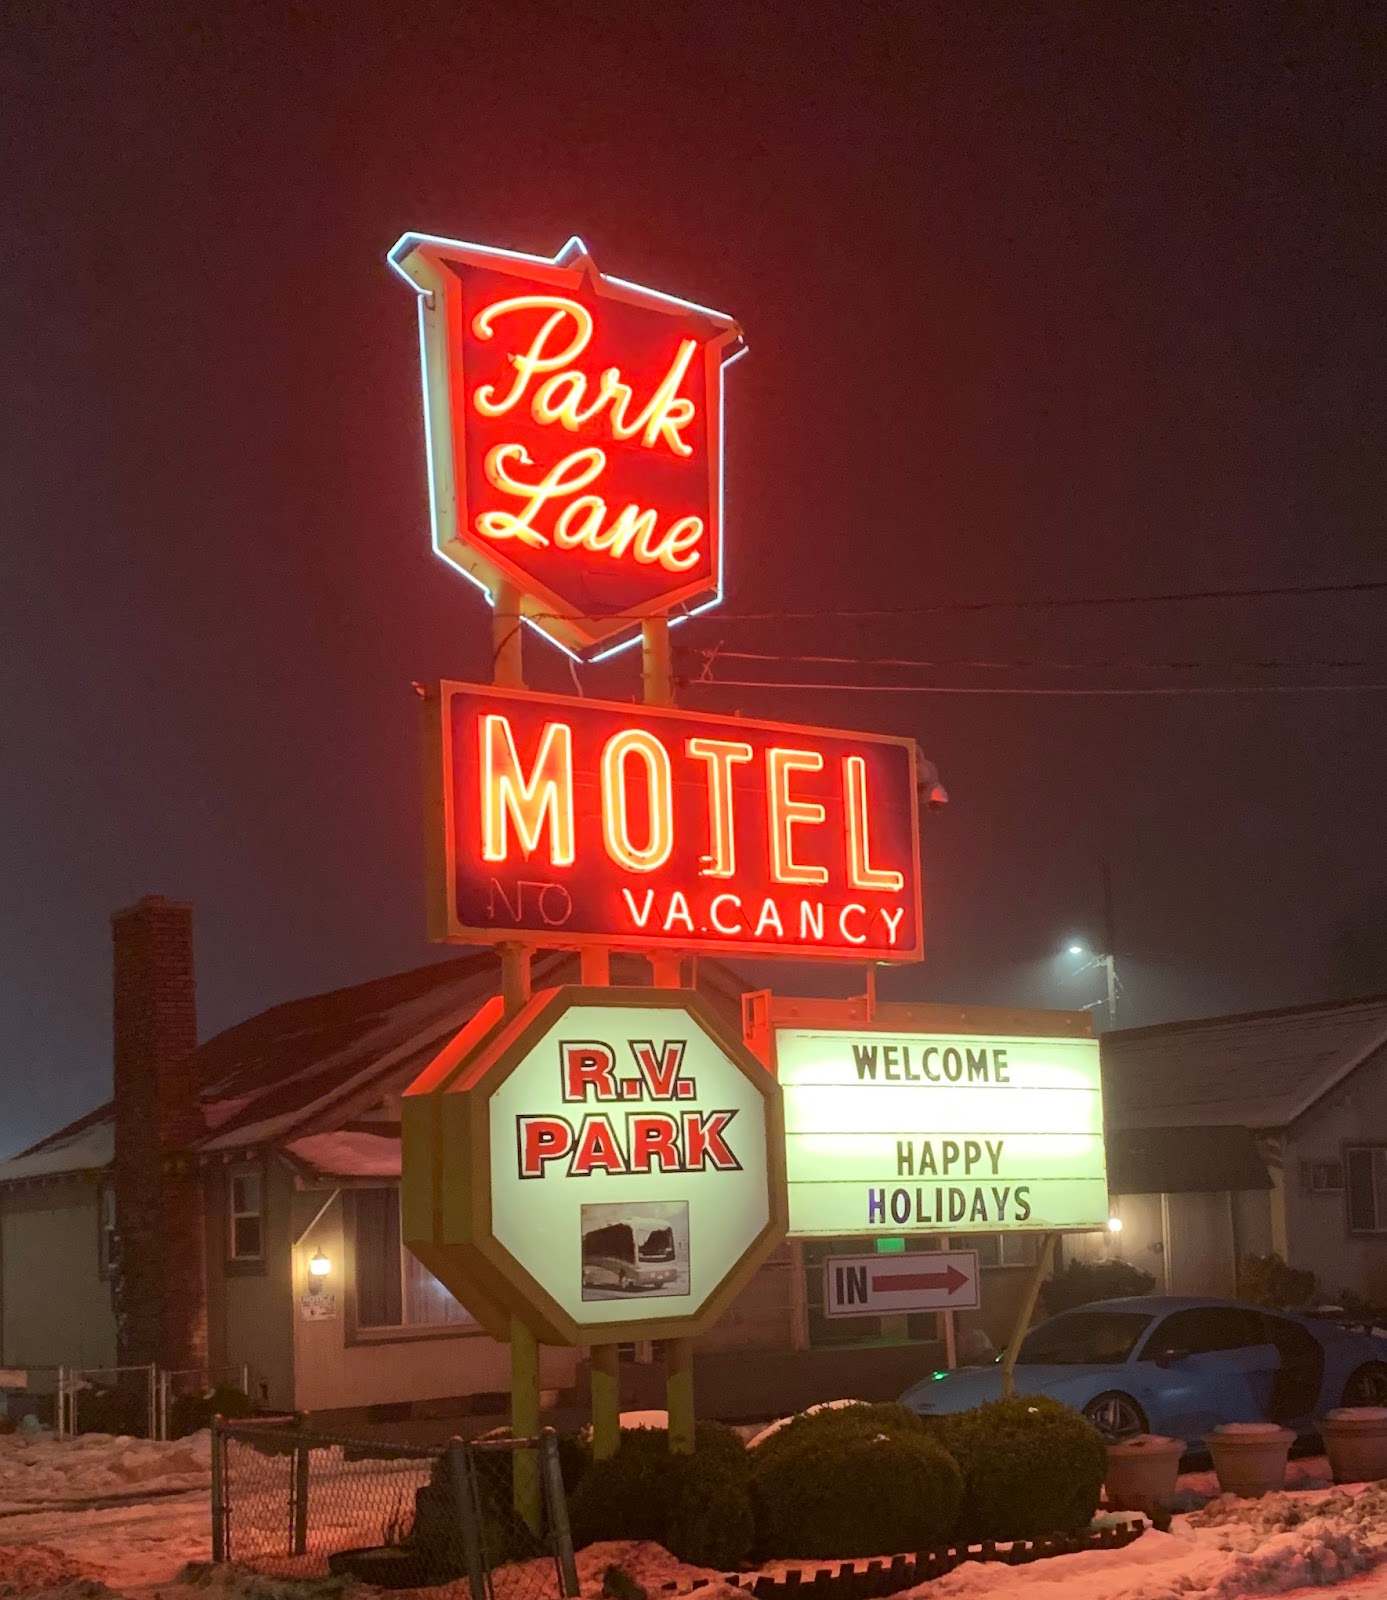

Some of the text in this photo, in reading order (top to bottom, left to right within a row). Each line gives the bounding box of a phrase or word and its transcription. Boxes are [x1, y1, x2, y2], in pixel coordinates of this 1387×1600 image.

[472, 296, 696, 457] Park
[474, 444, 703, 571] Lane
[478, 714, 904, 890] MOTEL
[487, 877, 905, 945] NO VACANCY
[558, 1039, 697, 1103] R.V.
[852, 1044, 1010, 1083] WELCOME
[515, 1109, 744, 1180] PARK
[896, 1140, 1004, 1176] HAPPY
[868, 1186, 1031, 1224] HOLIDAYS
[835, 1265, 869, 1306] IN
